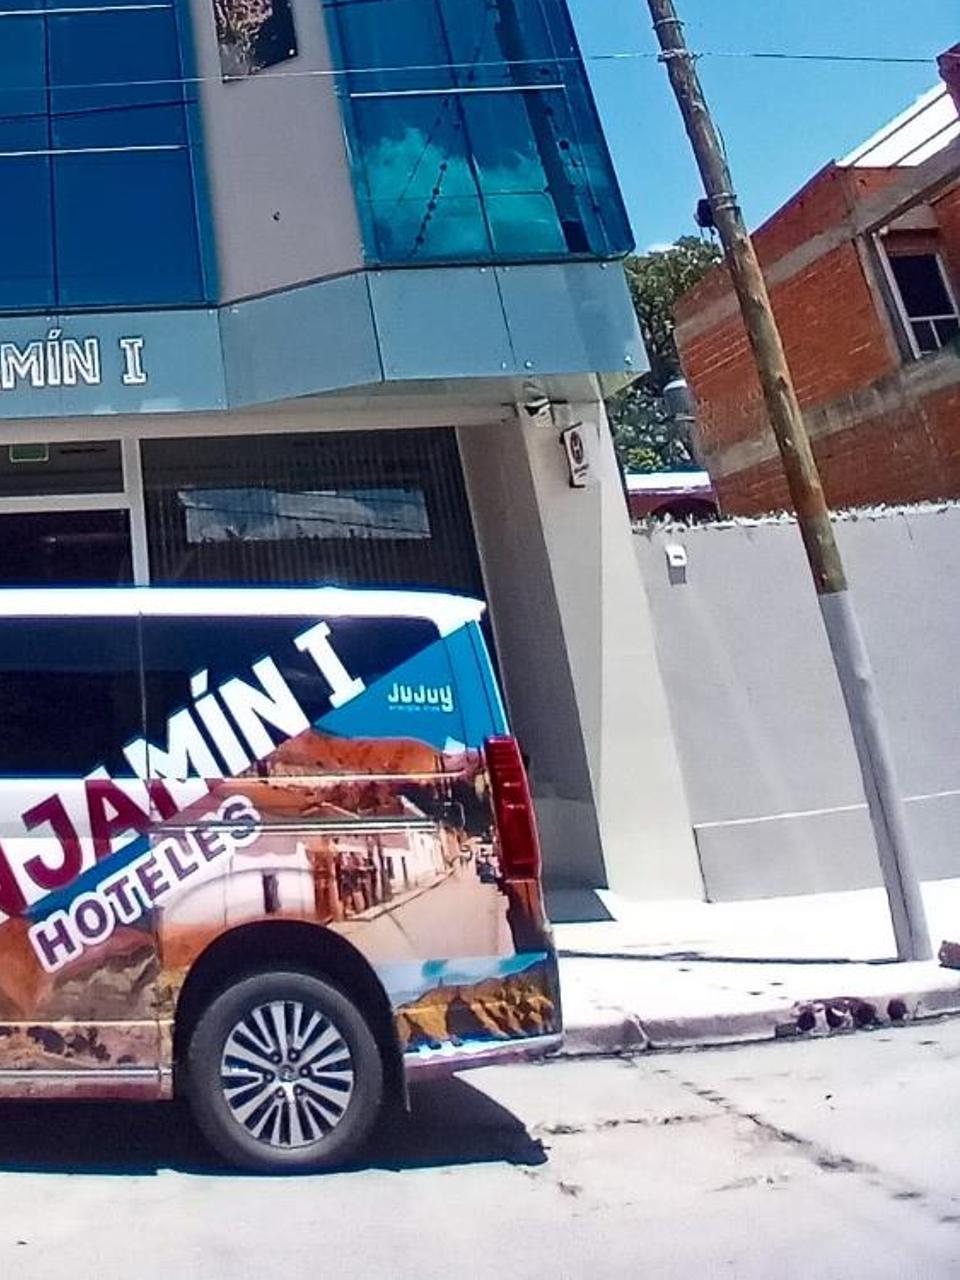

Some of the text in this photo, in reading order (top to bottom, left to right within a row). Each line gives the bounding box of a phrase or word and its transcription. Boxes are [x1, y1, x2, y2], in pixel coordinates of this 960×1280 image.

[120, 337, 147, 385] I
[294, 621, 367, 708] I
[35, 798, 260, 970] HOTELES
